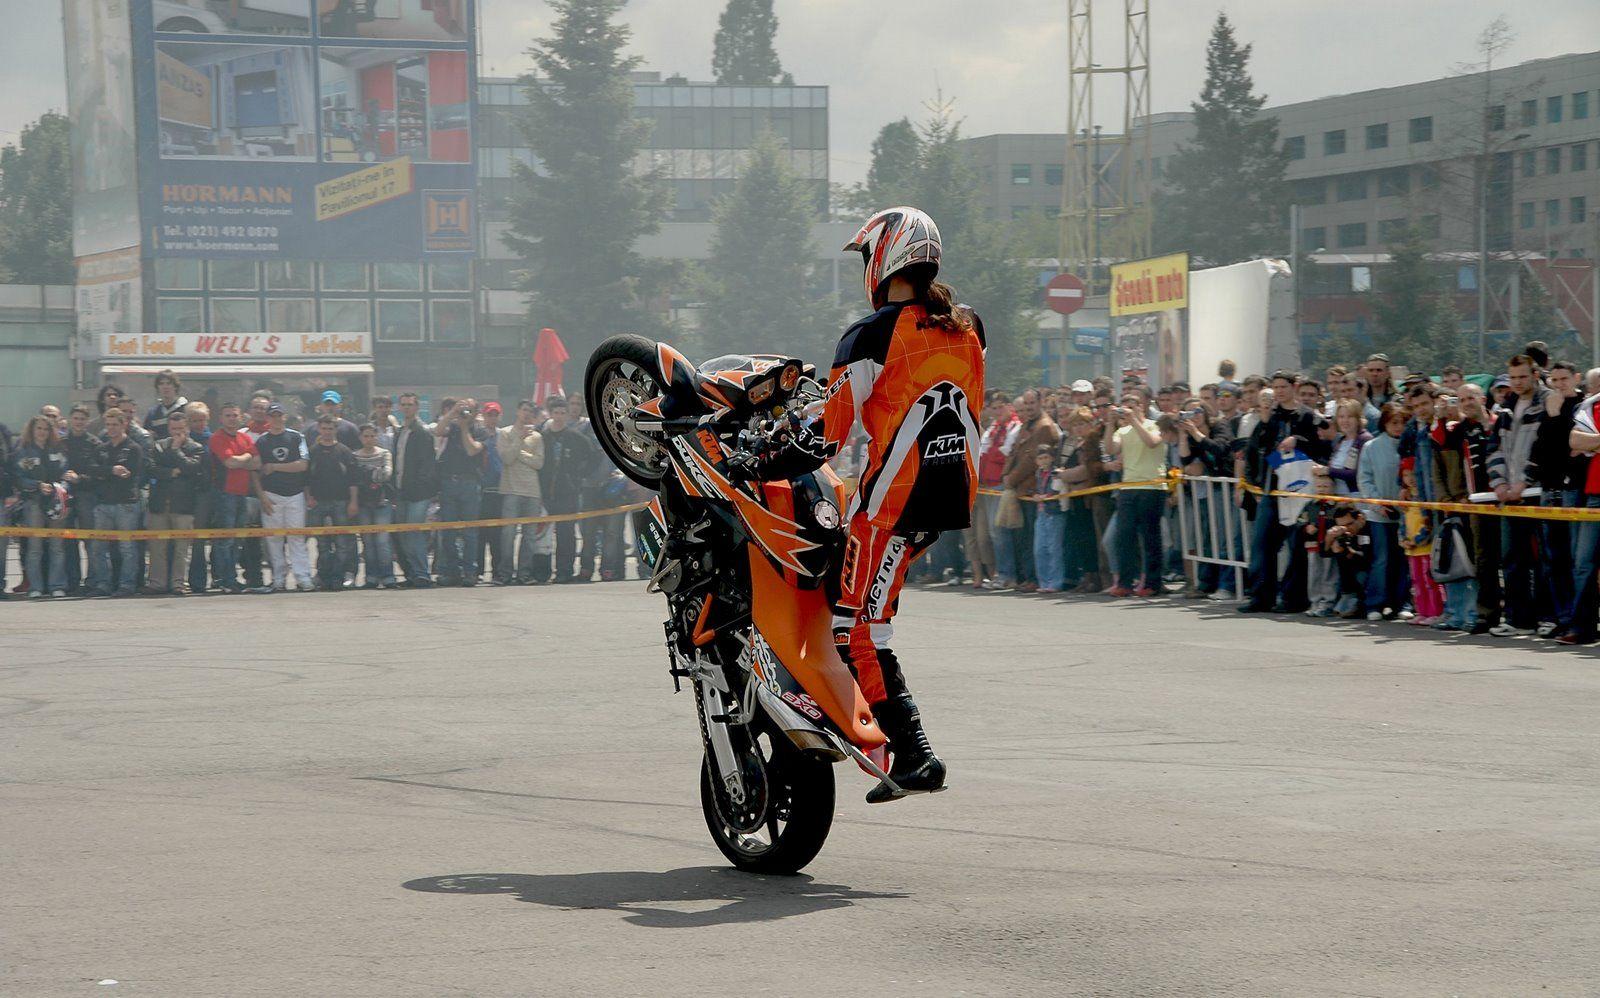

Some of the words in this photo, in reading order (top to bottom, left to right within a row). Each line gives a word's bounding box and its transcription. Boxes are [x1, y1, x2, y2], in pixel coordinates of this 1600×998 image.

[142, 335, 176, 354] Food
[331, 335, 363, 354] Food
[696, 428, 723, 465] KTM
[923, 433, 967, 459] KTM
[671, 434, 719, 499] DUKE
[842, 535, 861, 594] KTM
